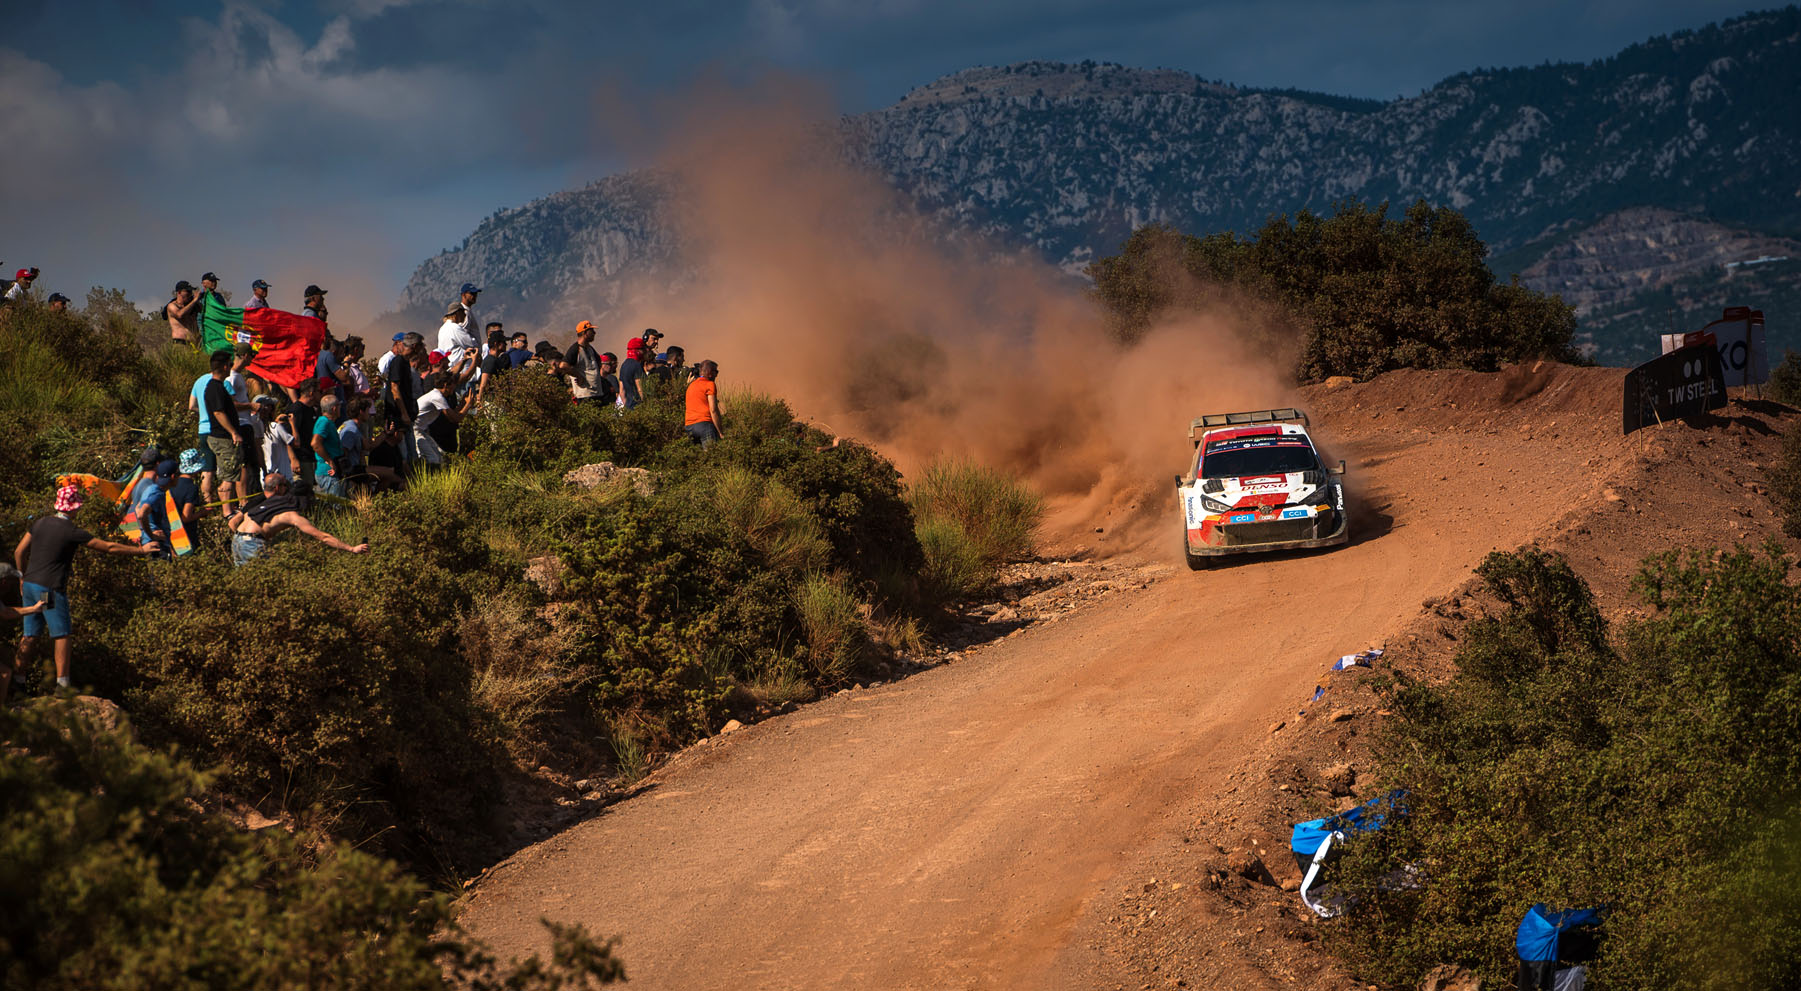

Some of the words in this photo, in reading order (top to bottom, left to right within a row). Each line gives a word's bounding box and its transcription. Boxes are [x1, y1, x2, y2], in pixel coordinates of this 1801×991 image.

[1719, 340, 1748, 371] KO
[1668, 386, 1686, 405] TW
[1687, 379, 1718, 400] STEL
[1241, 483, 1288, 491] DENSO
